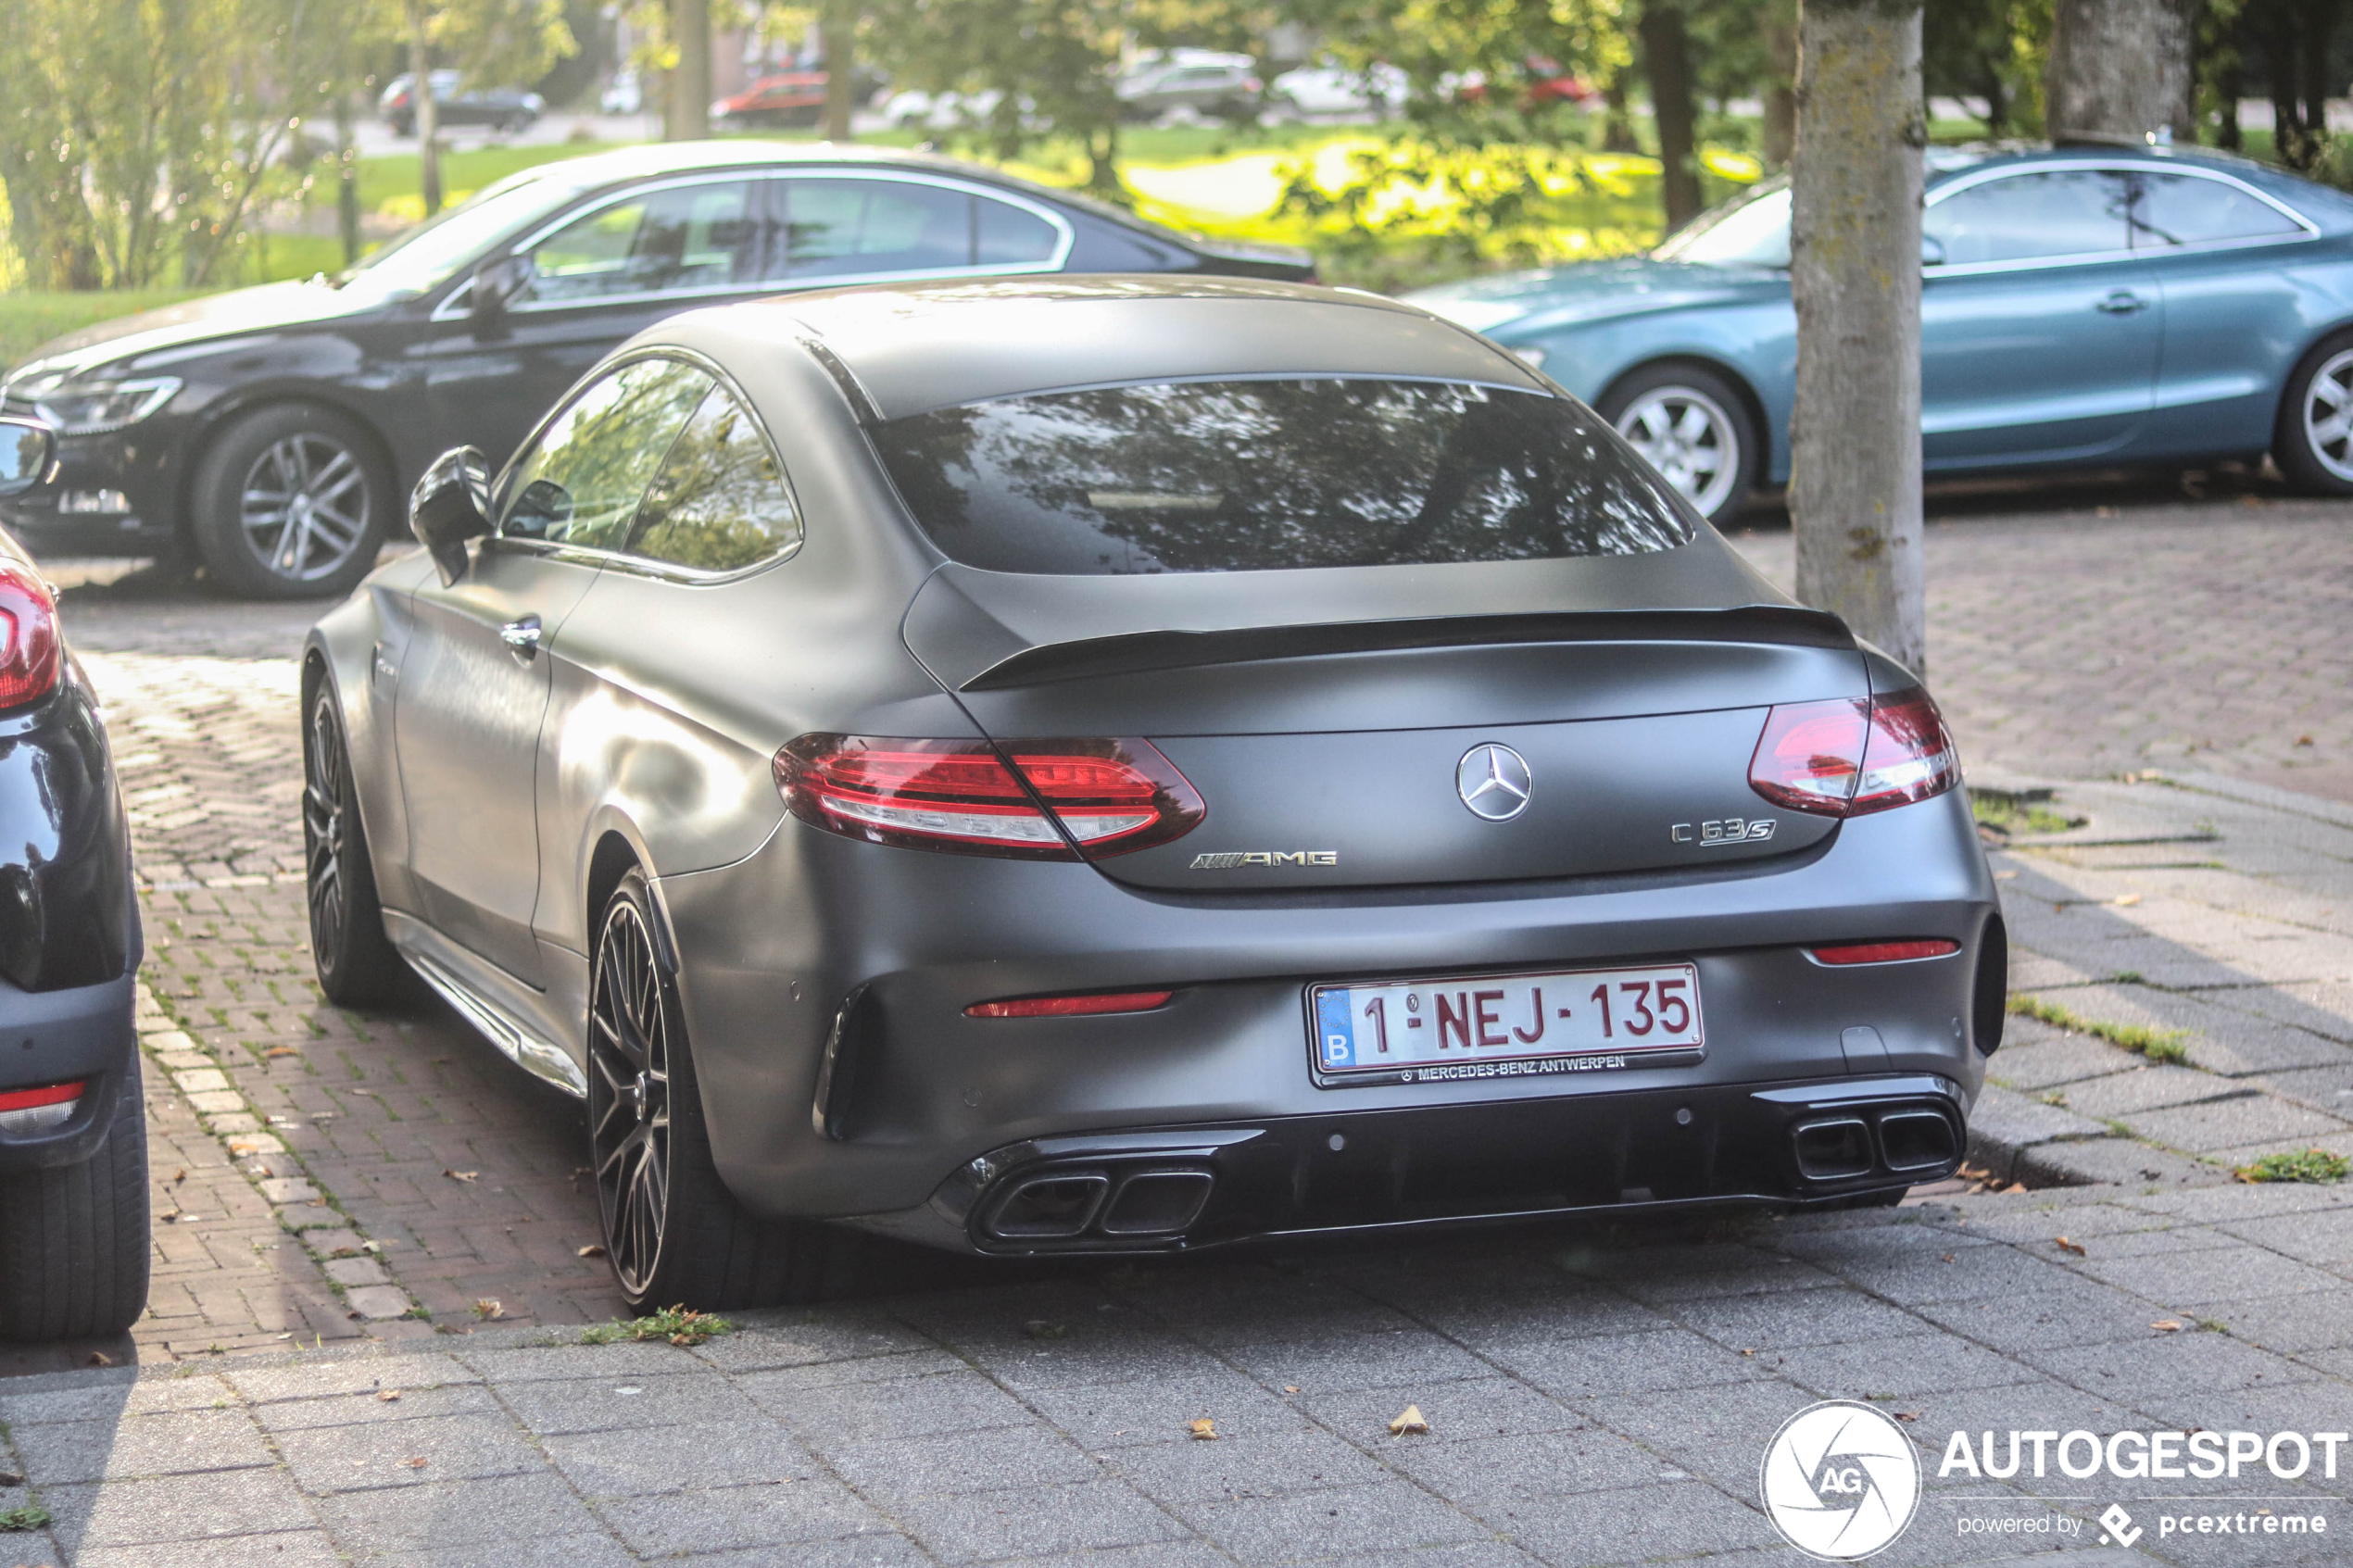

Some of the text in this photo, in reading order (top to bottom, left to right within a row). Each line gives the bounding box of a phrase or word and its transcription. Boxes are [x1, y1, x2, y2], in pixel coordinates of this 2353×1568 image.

[1671, 823, 1692, 843] C
[1237, 851, 1337, 867] AMG
[1327, 1035, 1350, 1060] B
[1418, 1055, 1625, 1081] MERCEDES-BENZ ANTWERPEN
